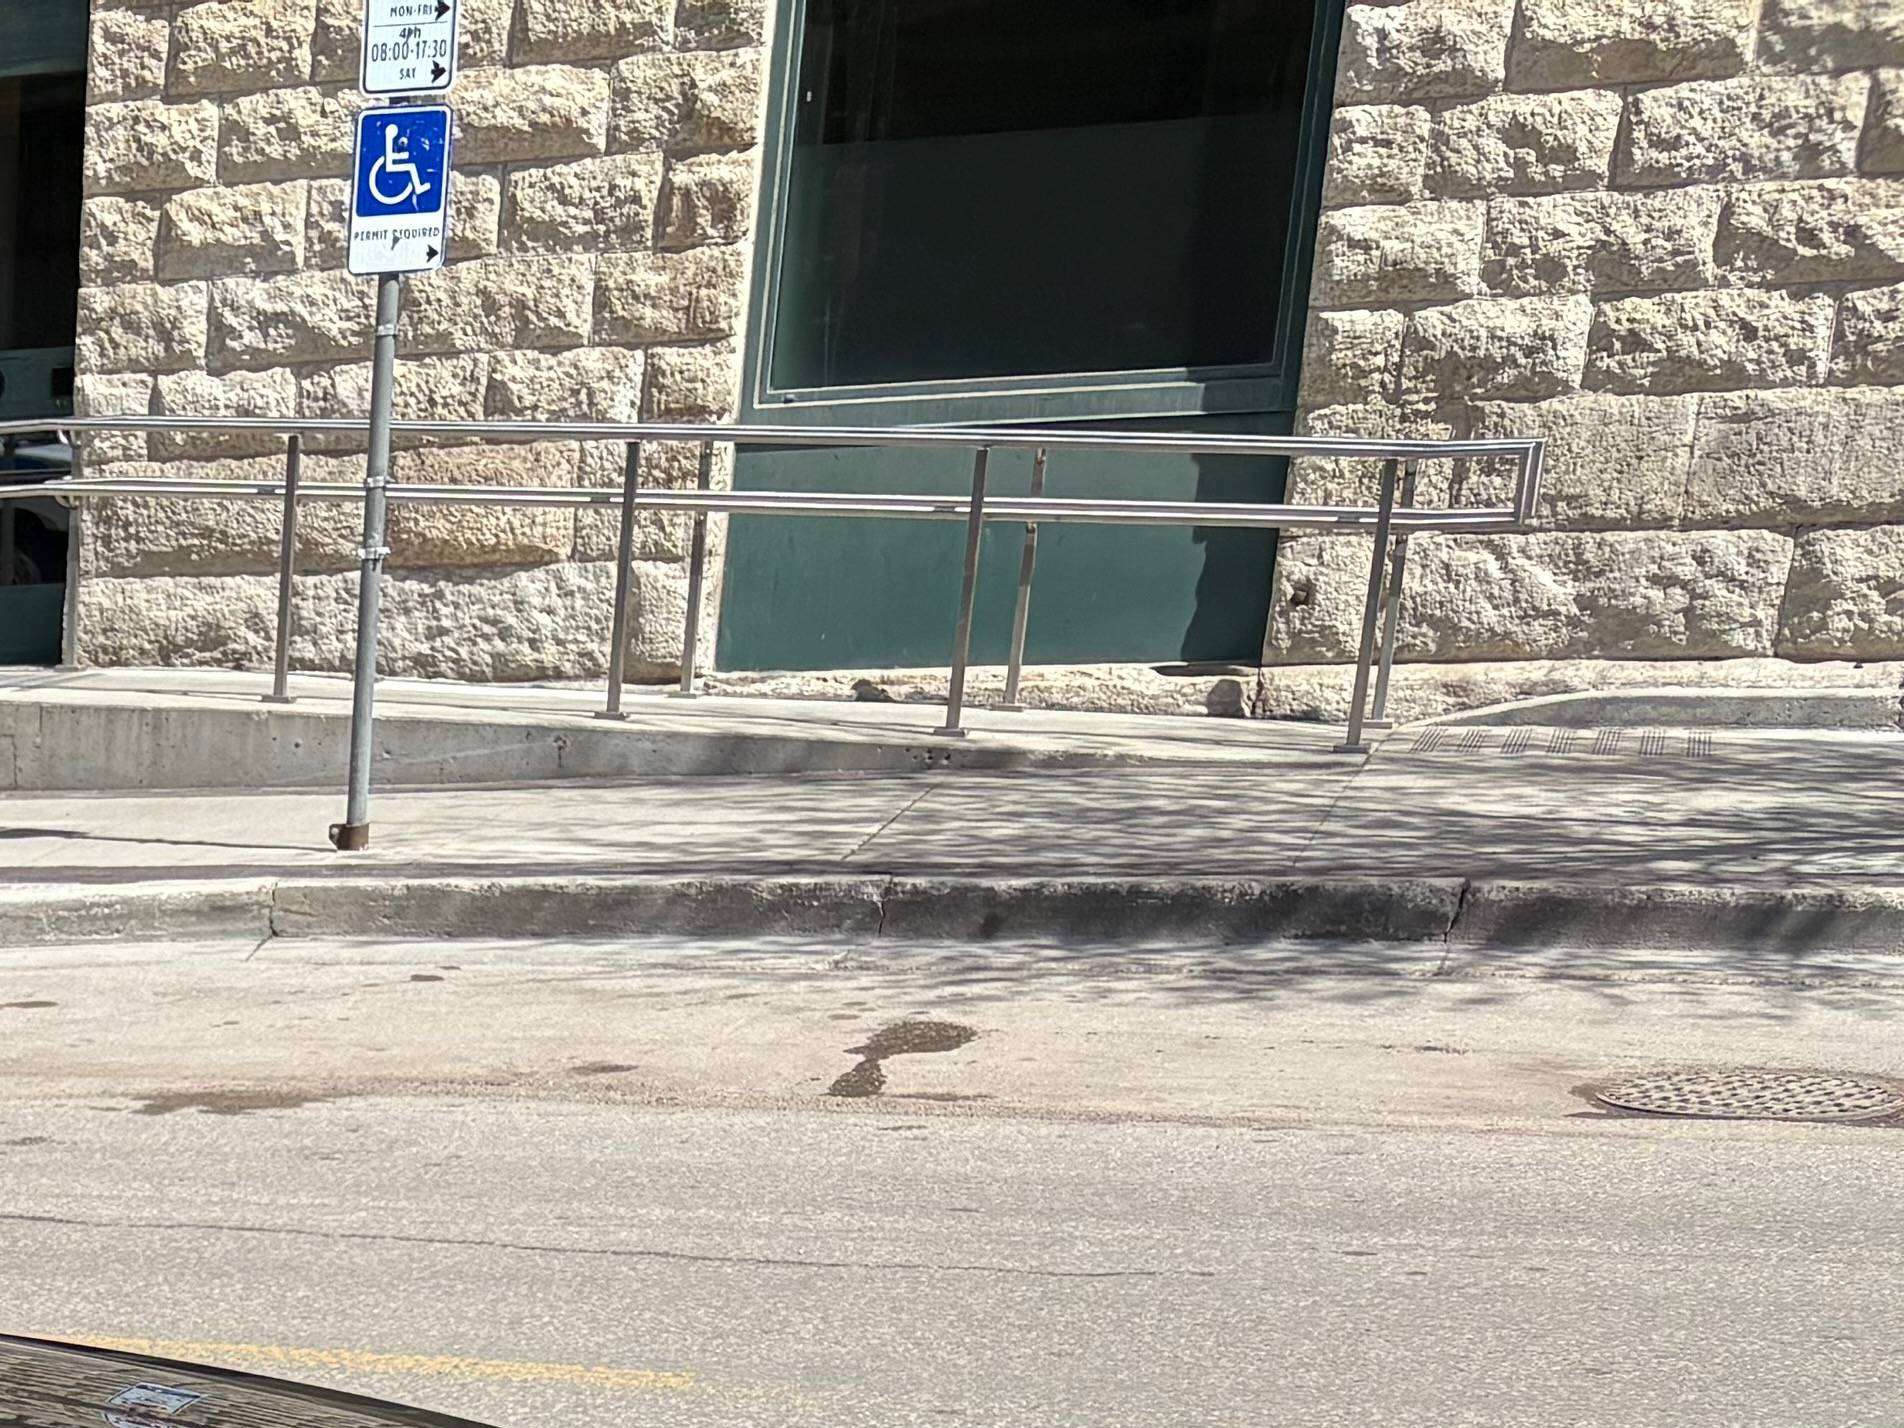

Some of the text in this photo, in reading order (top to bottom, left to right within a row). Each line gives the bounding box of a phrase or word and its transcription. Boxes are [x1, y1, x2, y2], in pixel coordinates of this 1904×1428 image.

[372, 40, 447, 62] 08:00-17:30
[400, 67, 416, 80] SAT
[354, 229, 388, 241] PERMIT
